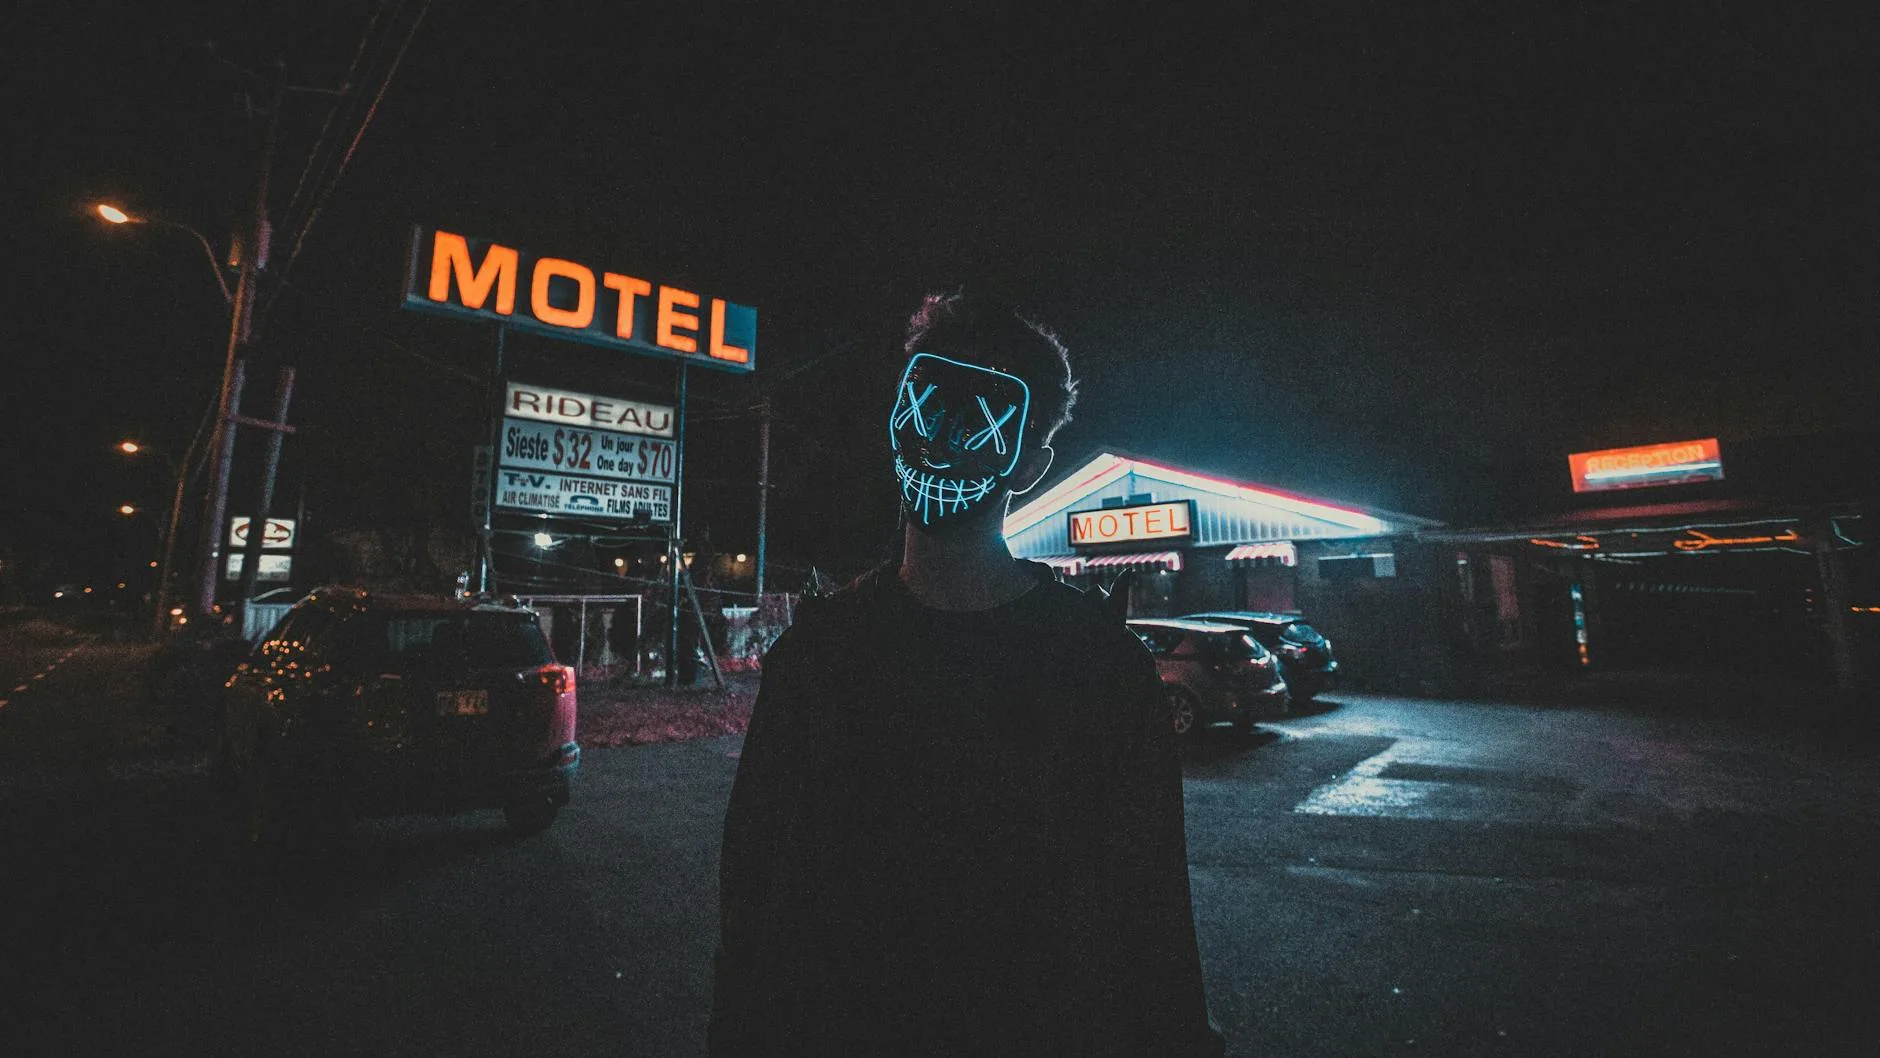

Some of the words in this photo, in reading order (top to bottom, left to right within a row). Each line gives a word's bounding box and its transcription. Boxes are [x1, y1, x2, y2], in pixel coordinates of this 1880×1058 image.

[429, 230, 748, 363] MOTEL
[513, 391, 669, 431] RIDEAU
[506, 427, 548, 461] Sieste
[601, 435, 613, 450] Un
[616, 437, 635, 455] jour
[597, 455, 614, 471] One
[618, 458, 634, 476] day
[502, 490, 517, 505] AIR
[560, 478, 618, 496] INTERNET
[621, 484, 650, 500] SANS
[652, 488, 668, 501] FIL
[607, 498, 631, 514] FILMS
[1072, 509, 1187, 540] MOTEL
